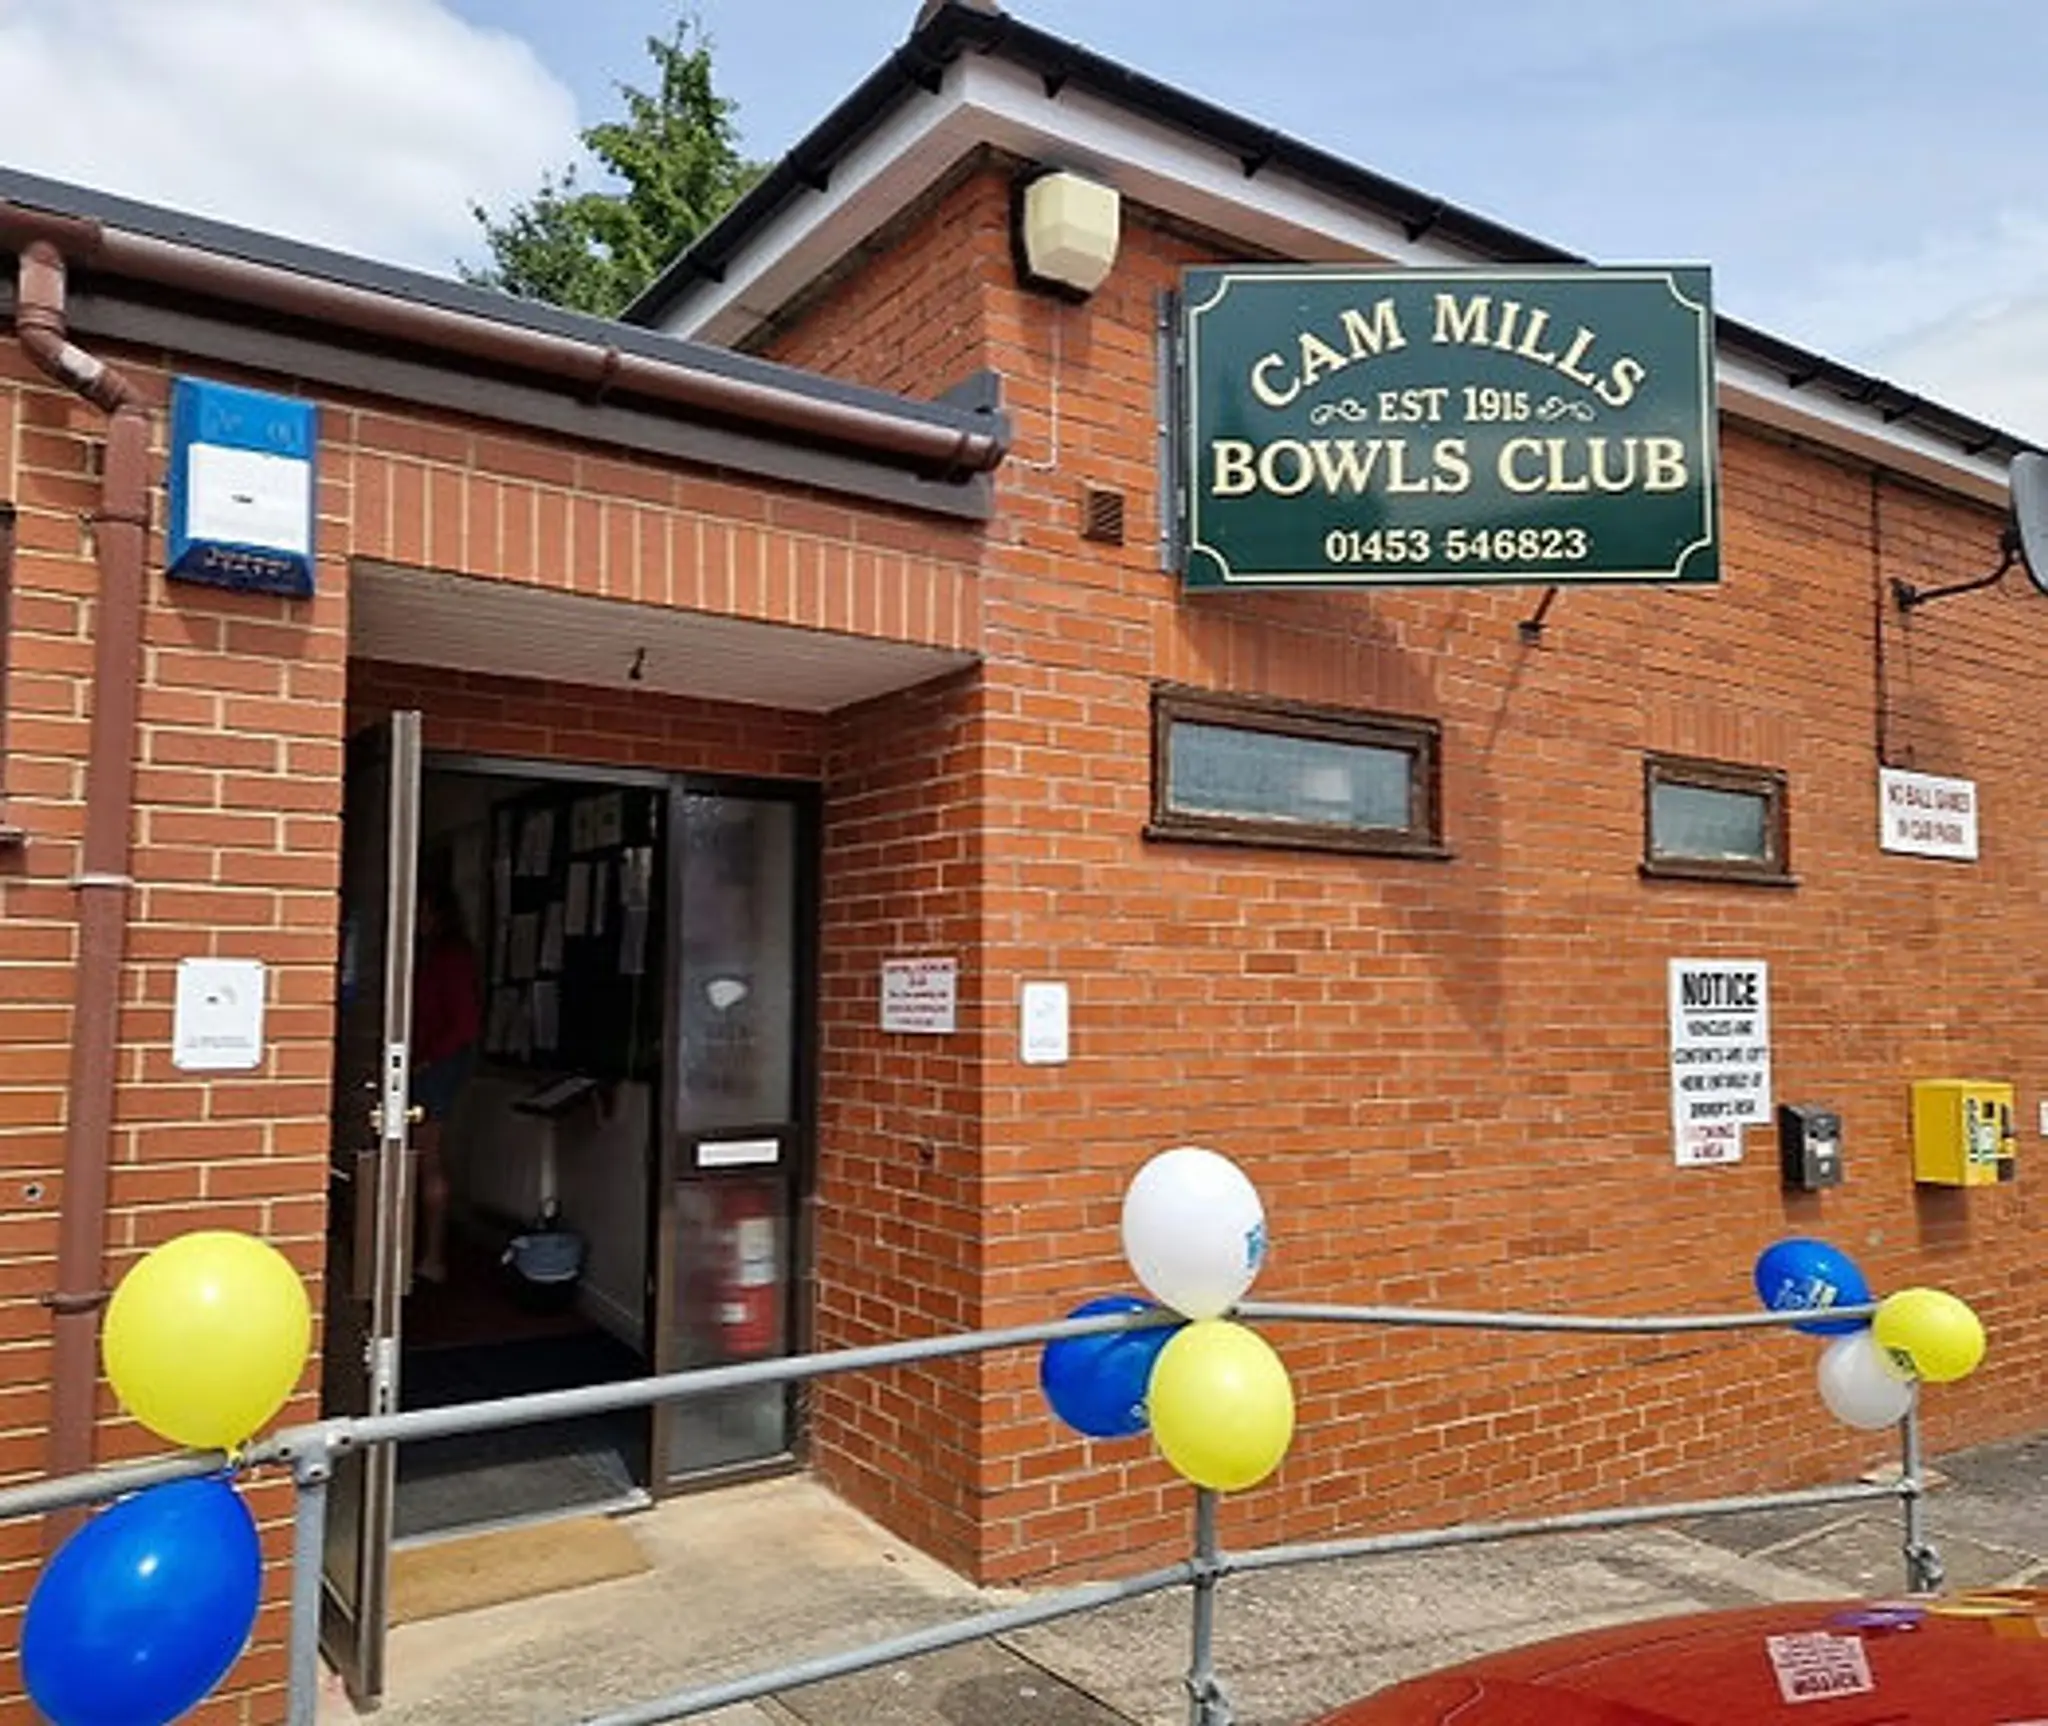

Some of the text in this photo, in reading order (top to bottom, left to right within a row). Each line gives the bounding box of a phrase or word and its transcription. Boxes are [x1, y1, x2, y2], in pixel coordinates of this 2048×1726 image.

[1251, 293, 1646, 408] CAM MILLS
[1379, 386, 1531, 422] EST 1915
[1211, 437, 1689, 495] BOWLS CLUB
[1325, 528, 1588, 563] 01453 546823
[1682, 972, 1759, 1006] NOTICE
